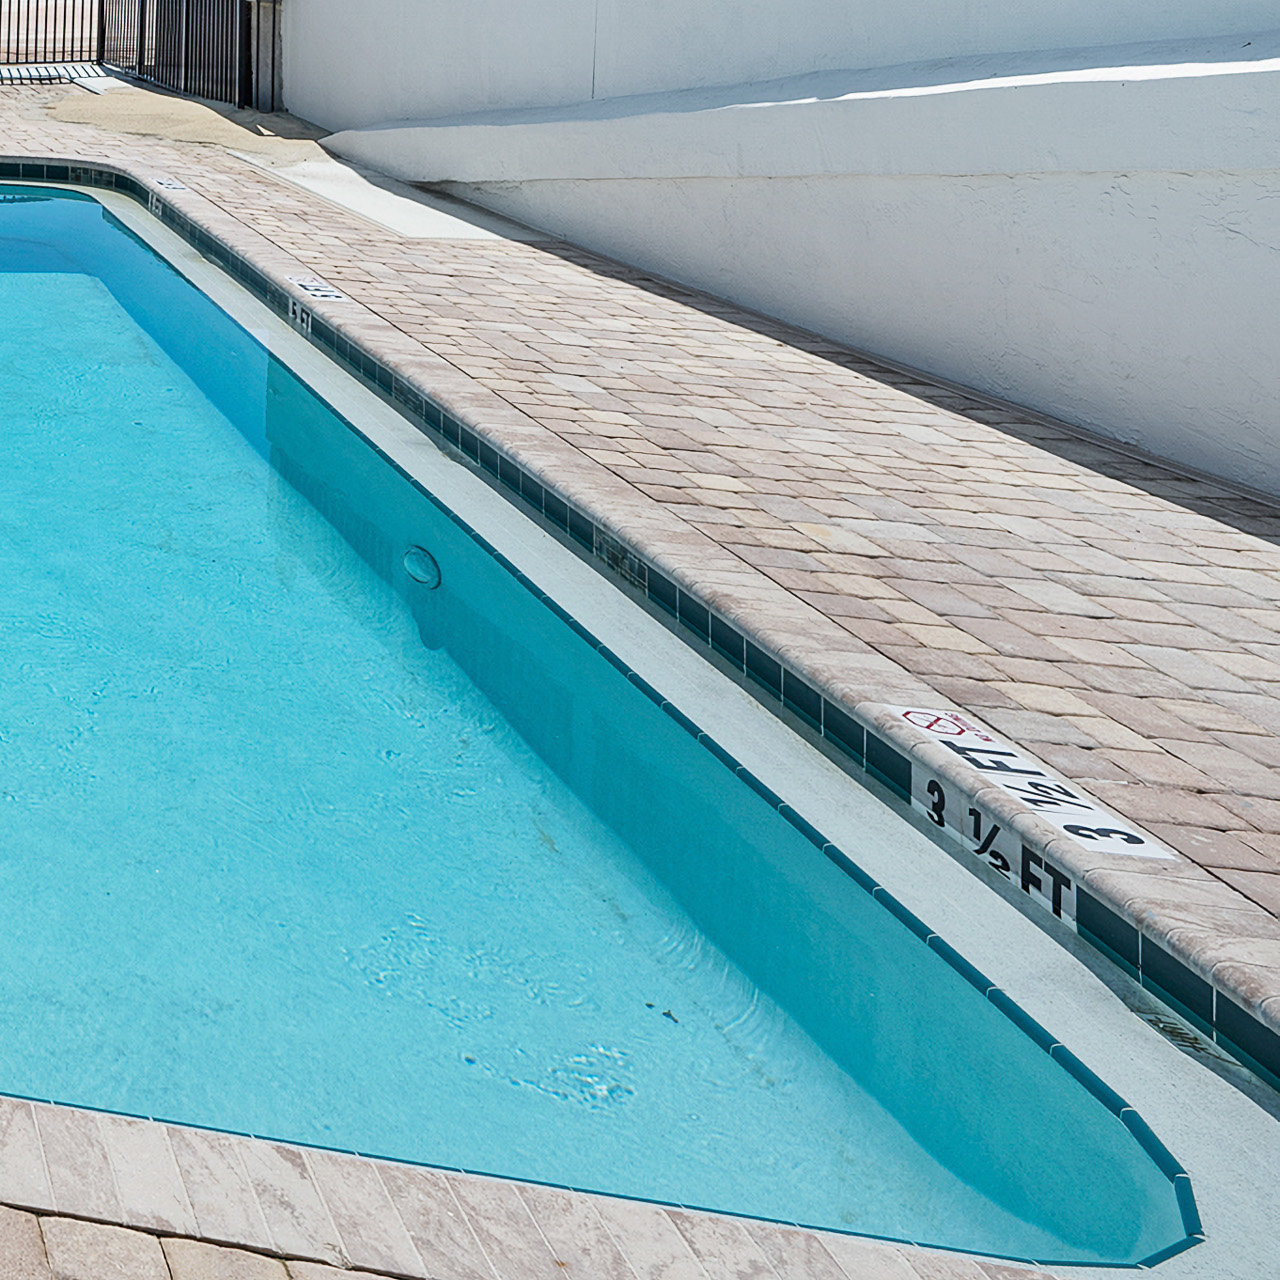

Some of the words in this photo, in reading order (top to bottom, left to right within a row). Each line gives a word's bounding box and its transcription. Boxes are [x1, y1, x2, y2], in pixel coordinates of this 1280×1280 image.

[939, 739, 1047, 777] FT
[926, 779, 946, 828] 3
[1021, 844, 1071, 919] FT
[1062, 824, 1146, 846] 3
